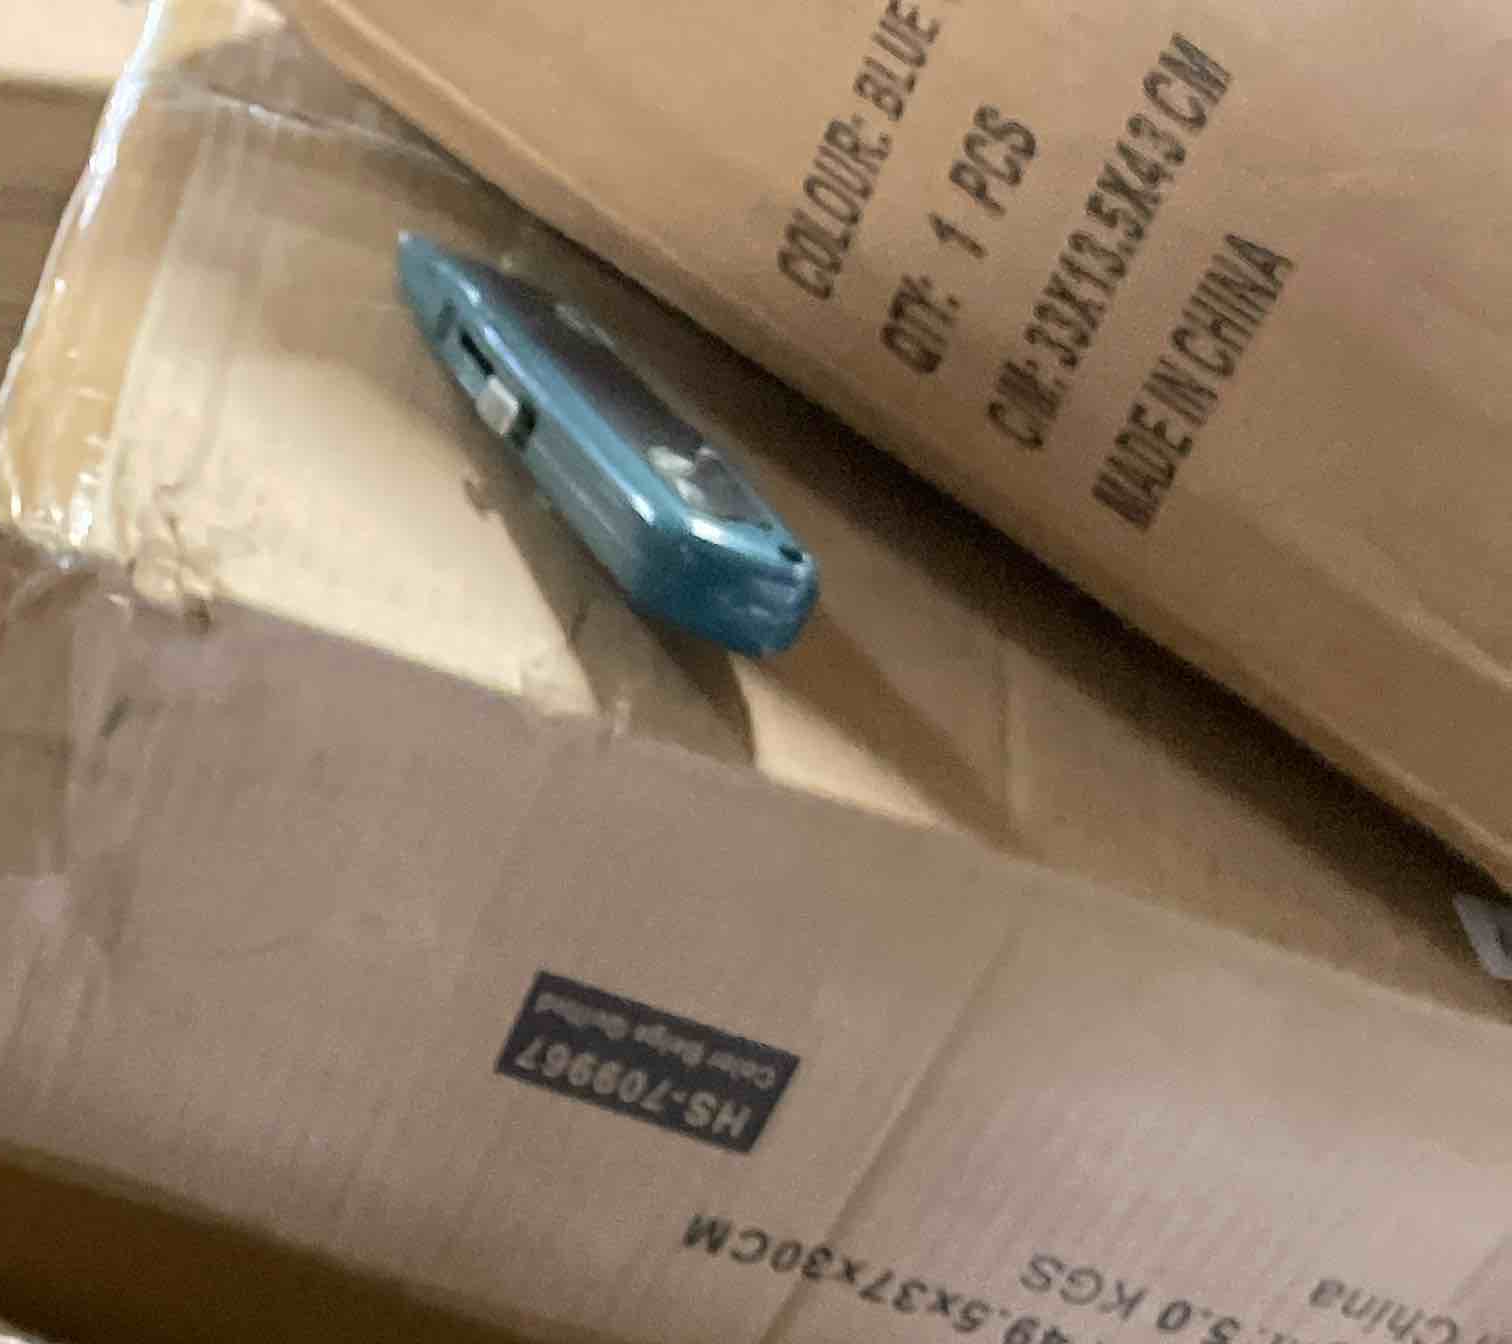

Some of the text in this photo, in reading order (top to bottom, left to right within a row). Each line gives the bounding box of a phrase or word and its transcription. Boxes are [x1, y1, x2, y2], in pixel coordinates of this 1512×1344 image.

[777, 0, 940, 301] COLOUR: BLUE
[880, 105, 1039, 375] QTY: 1 PCS
[1023, 115, 1187, 370] 33X13.5X43
[1145, 31, 1234, 132] CM
[1093, 233, 1294, 533] MADE IN CHINA
[1020, 1253, 1146, 1321] KGS
